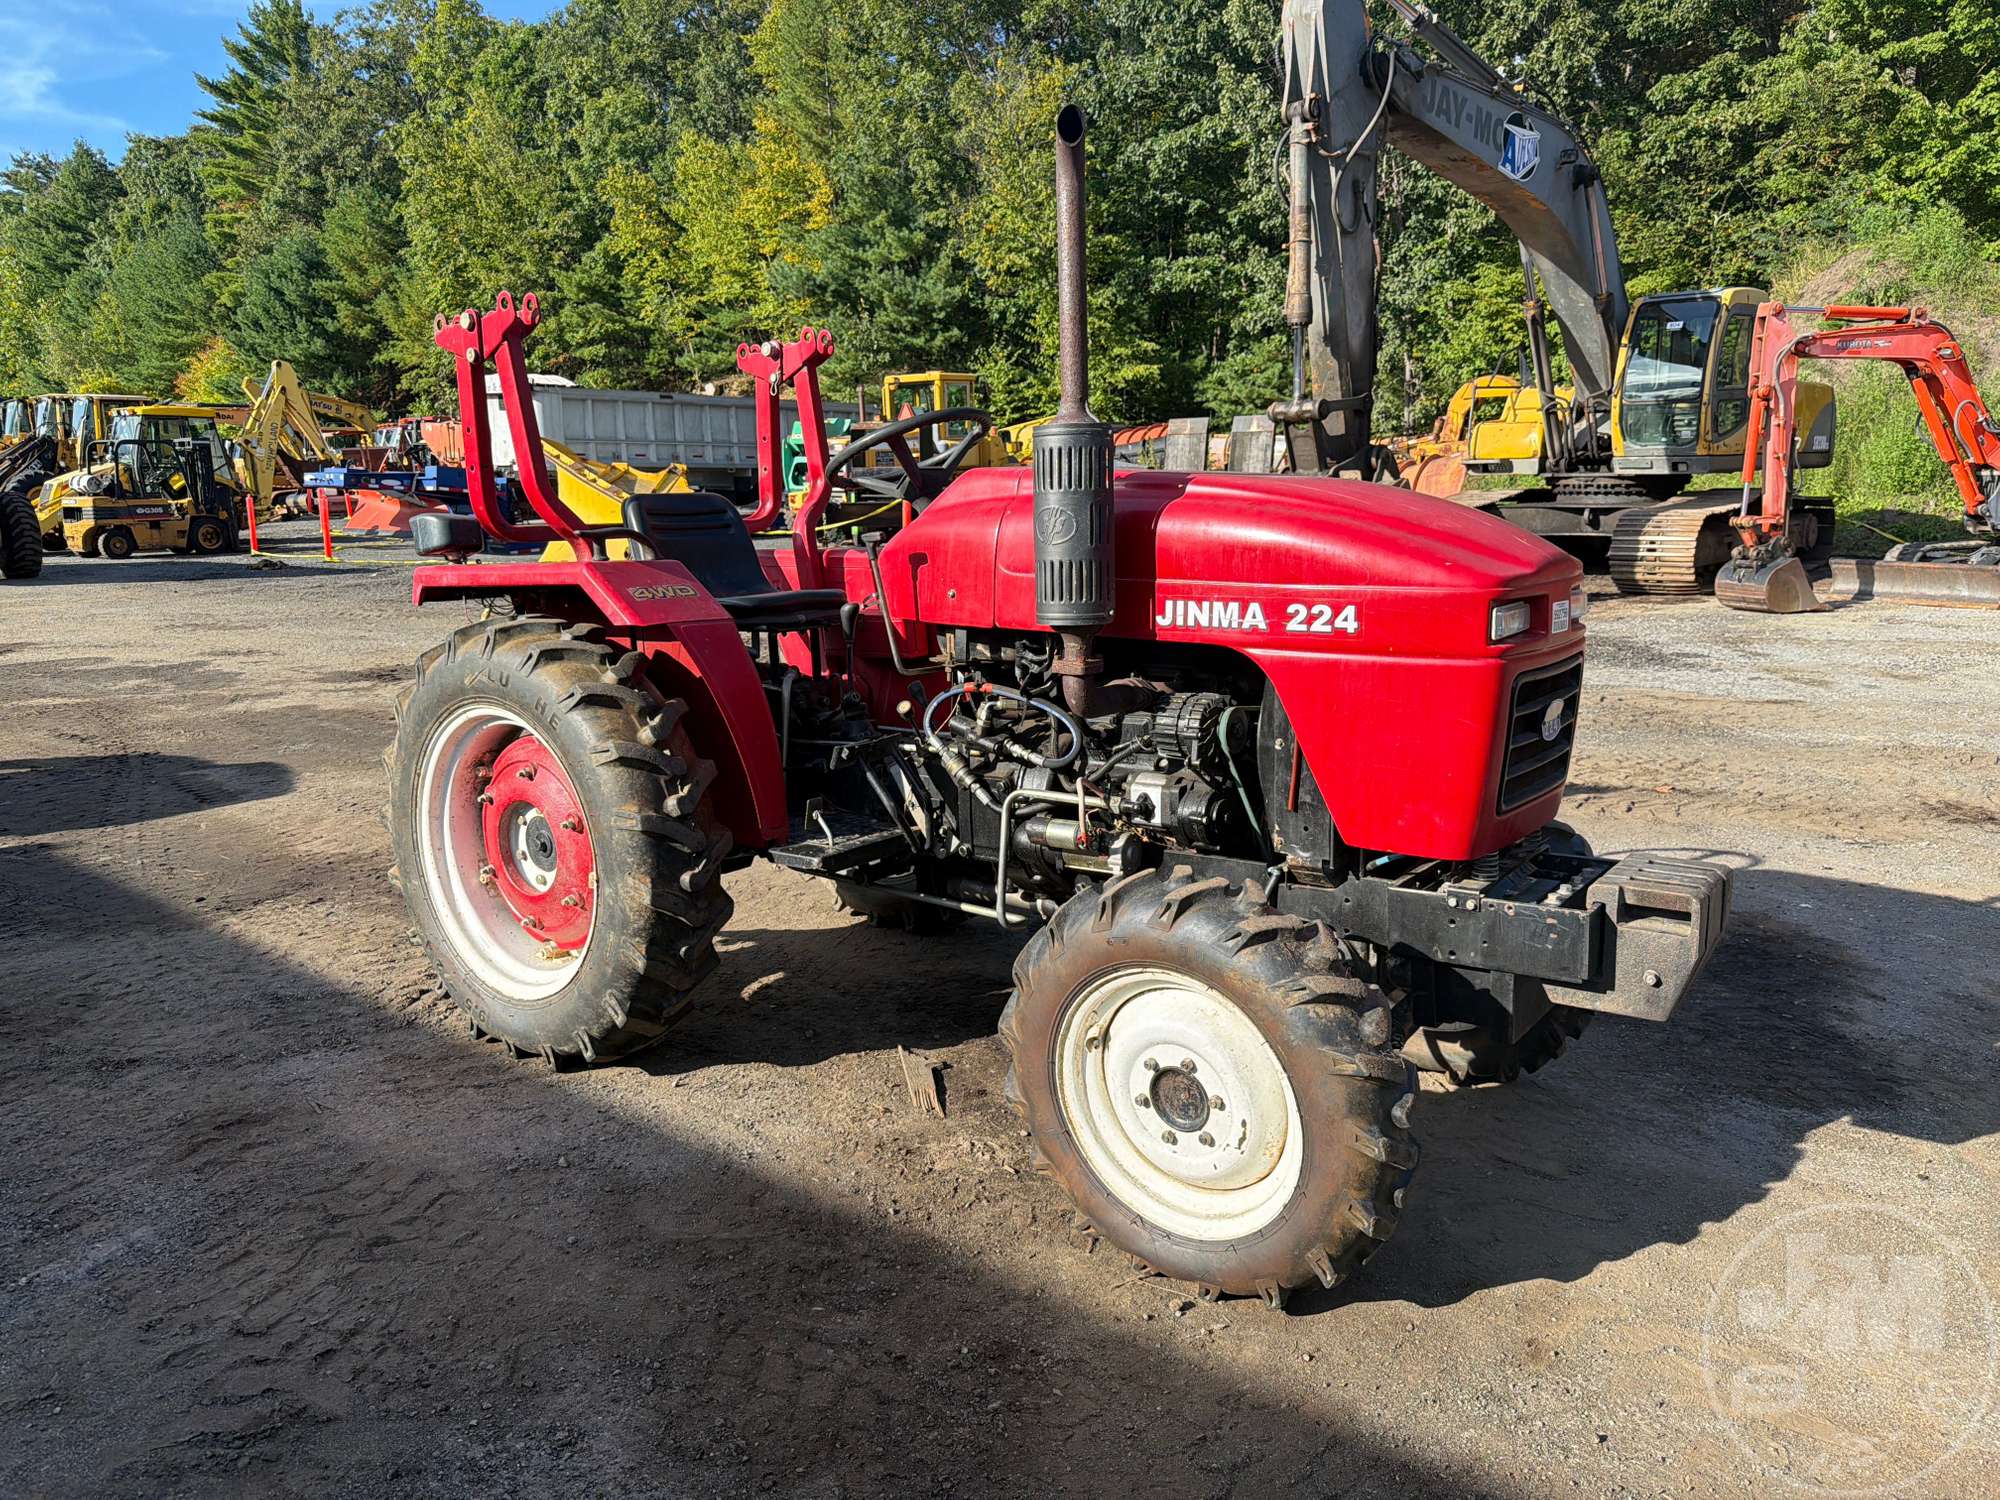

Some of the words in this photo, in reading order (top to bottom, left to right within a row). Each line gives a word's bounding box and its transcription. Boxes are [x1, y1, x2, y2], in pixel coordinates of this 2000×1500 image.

[1836, 339, 1873, 350] KUBOTA
[629, 584, 699, 600] 4WD
[1155, 600, 1268, 630] JINMA
[1285, 604, 1360, 633] 224
